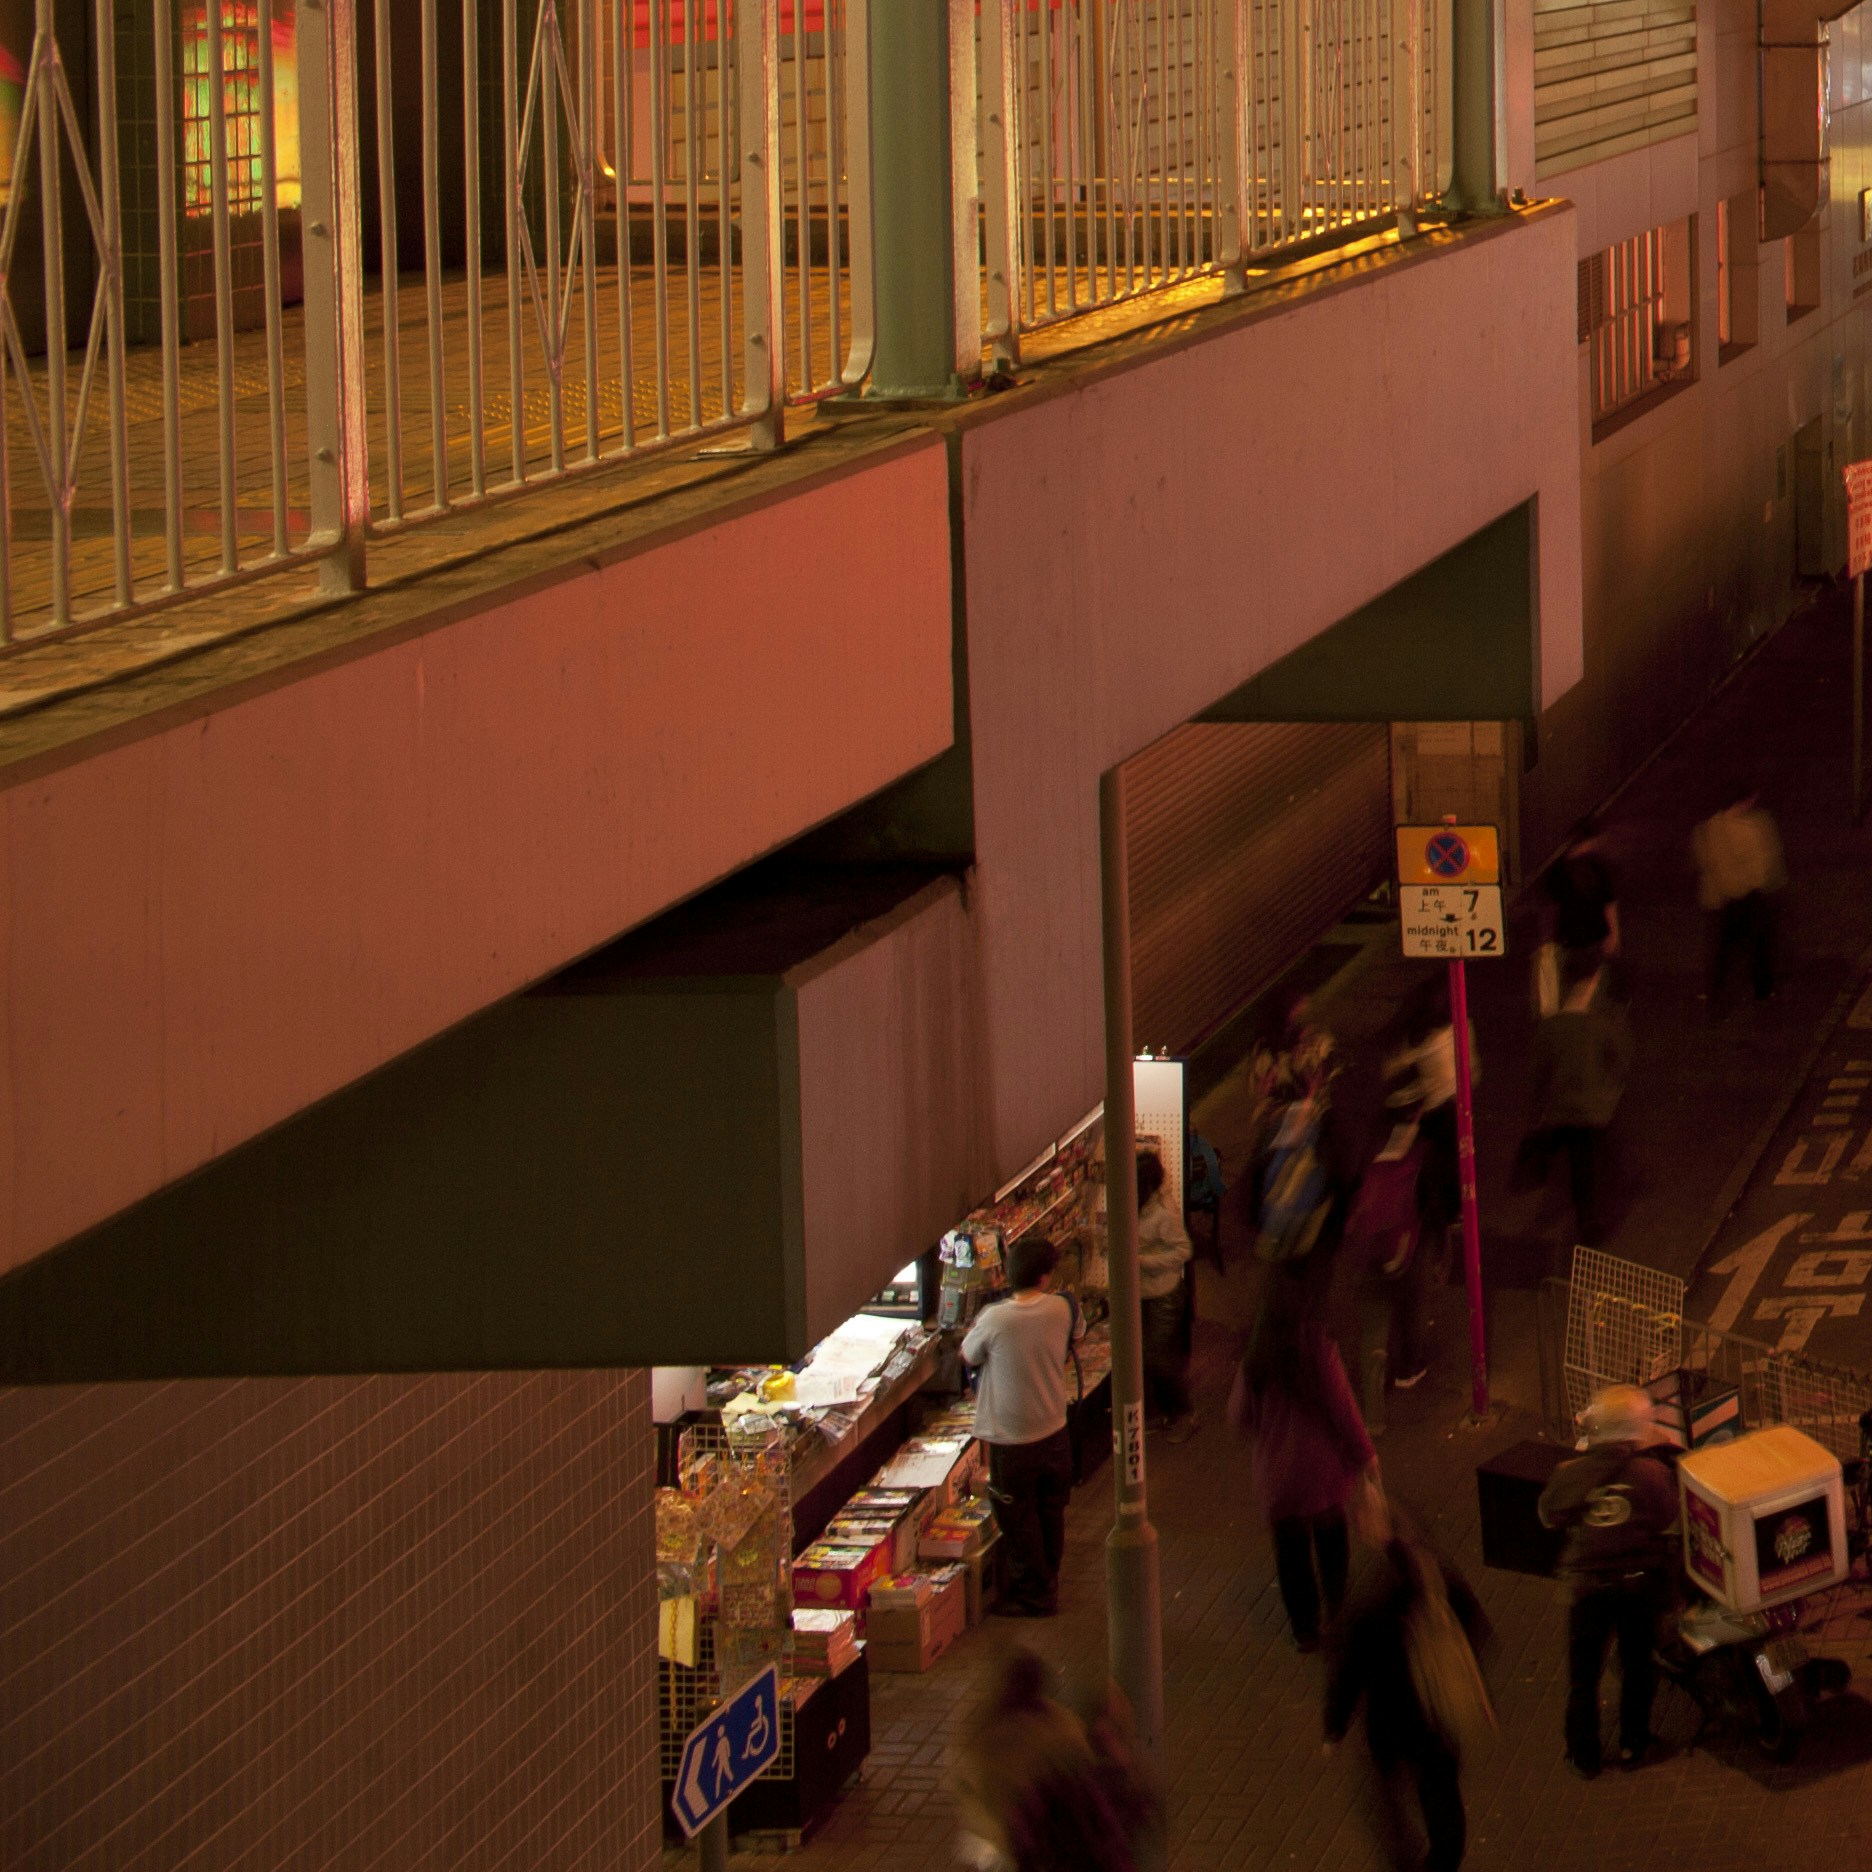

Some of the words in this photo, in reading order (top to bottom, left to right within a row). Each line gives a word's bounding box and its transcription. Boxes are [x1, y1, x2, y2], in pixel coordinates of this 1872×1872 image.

[1422, 888, 1440, 897] am
[1418, 899, 1446, 913] 上午
[1463, 890, 1479, 913] 7
[1407, 925, 1460, 939] midnight
[1419, 939, 1449, 953] 午夜
[1466, 929, 1497, 952] 12
